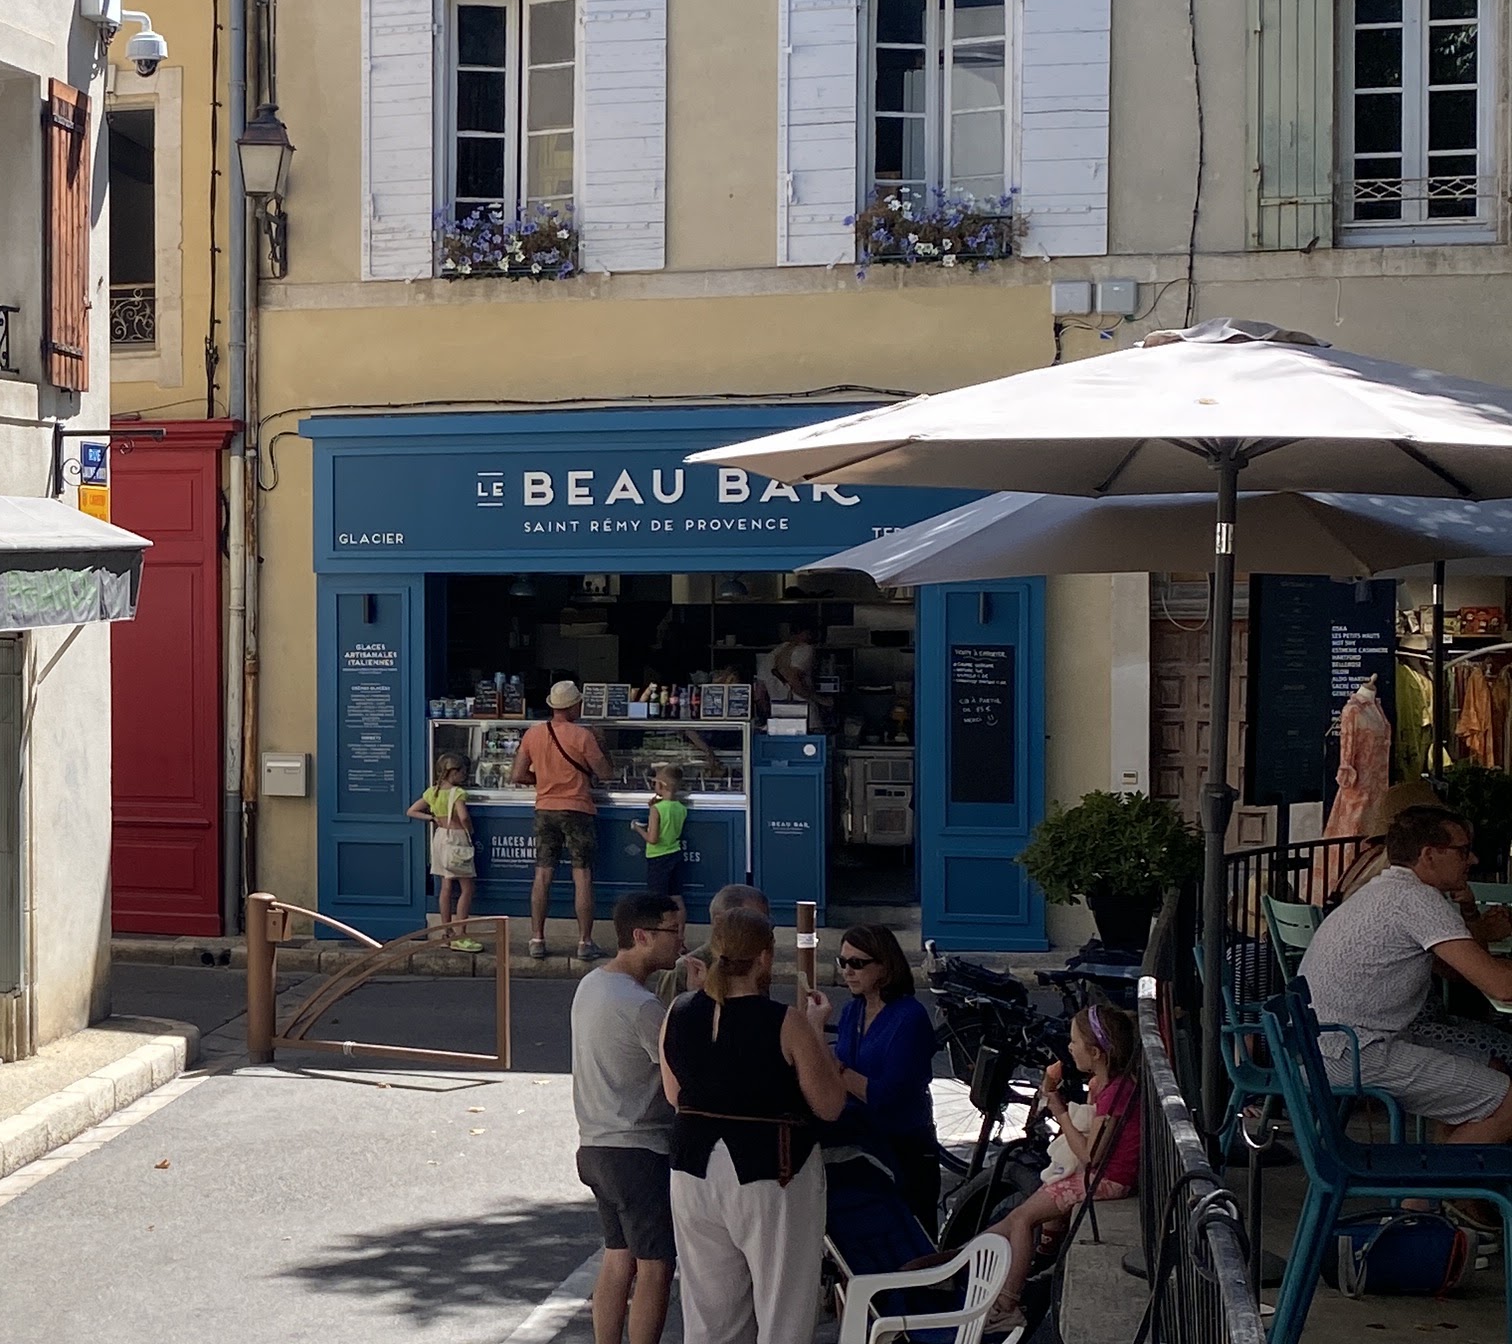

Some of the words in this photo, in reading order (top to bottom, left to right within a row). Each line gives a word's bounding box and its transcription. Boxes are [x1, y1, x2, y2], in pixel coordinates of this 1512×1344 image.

[477, 481, 504, 497] LE
[523, 467, 685, 506] BEAU
[718, 467, 862, 507] BAR
[523, 520, 580, 533] SAINT
[590, 517, 641, 532] RÉMY
[651, 519, 675, 532] DE
[685, 517, 790, 532] PROVENCE
[338, 532, 404, 545] GLACIER
[355, 643, 386, 651] GLACES
[344, 651, 398, 659] ARTISANALES
[491, 836, 525, 847] GLACES
[491, 847, 538, 859] ITALIENNE
